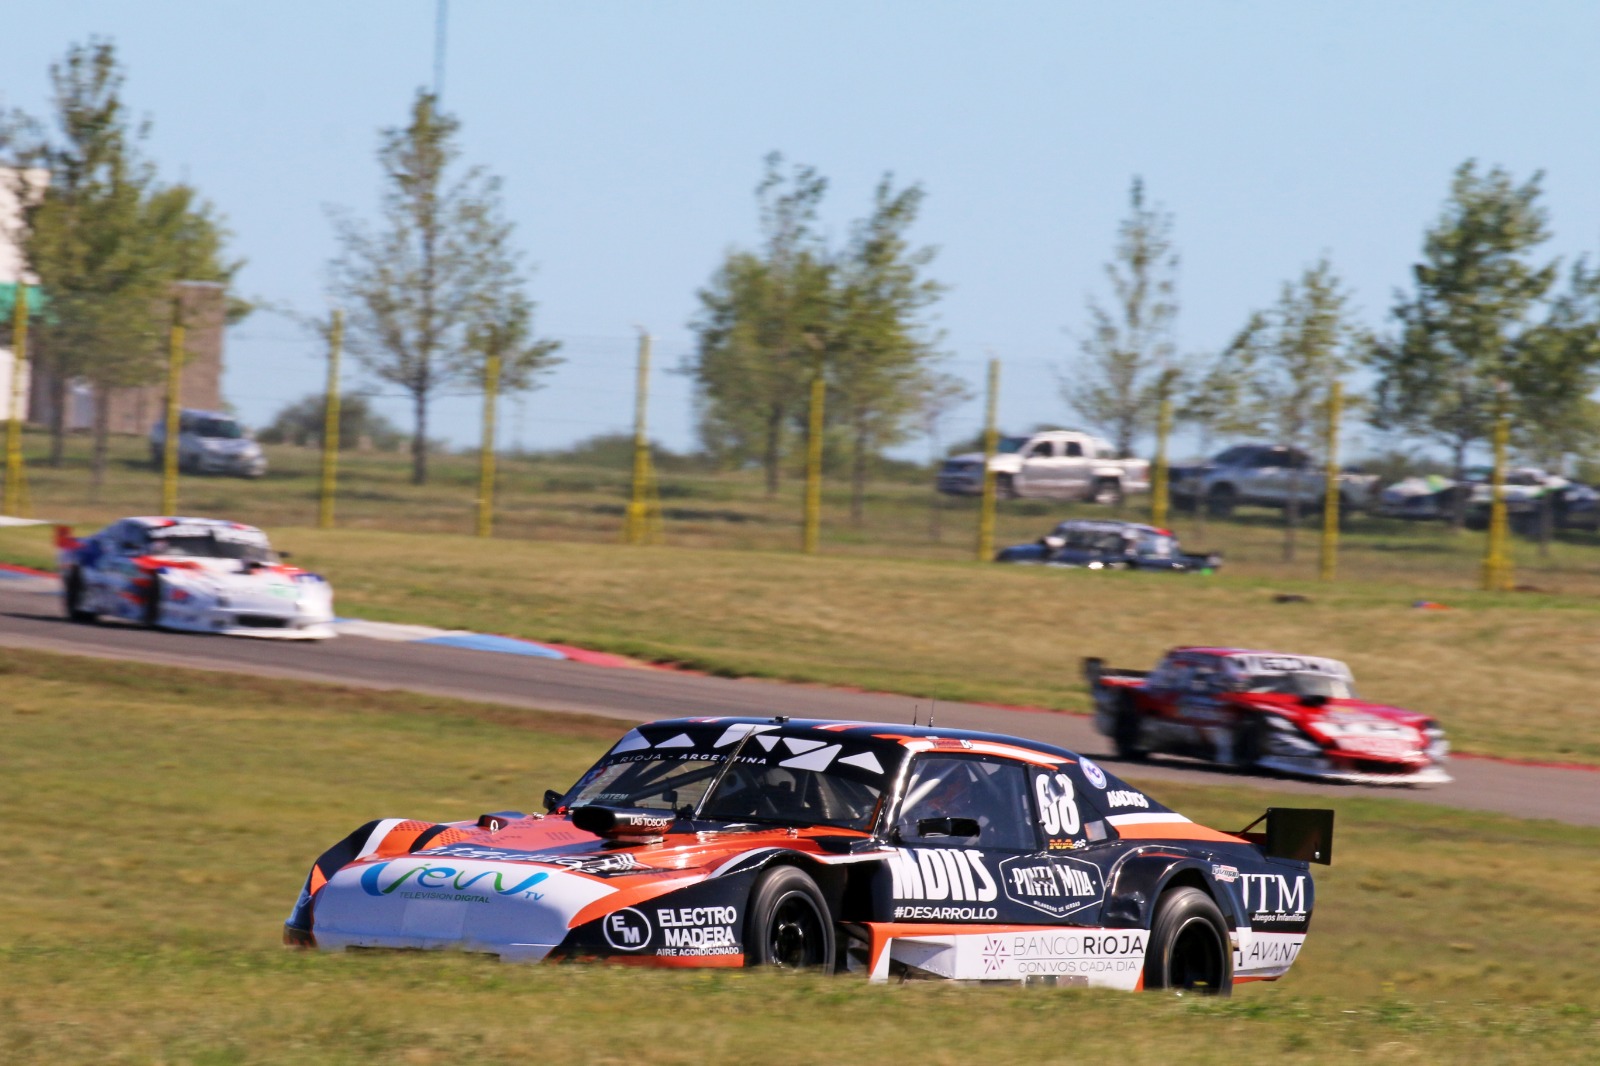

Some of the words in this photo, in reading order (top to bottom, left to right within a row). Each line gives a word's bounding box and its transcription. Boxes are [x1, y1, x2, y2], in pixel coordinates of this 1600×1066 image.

[620, 753, 662, 764] RIOJA
[679, 753, 767, 764] ARGENTINA
[630, 817, 643, 826] LAS
[643, 817, 667, 827] TOSCAS
[399, 892, 454, 901] TELEVISION
[454, 894, 490, 903] DIGITAL
[524, 891, 545, 901] TV
[657, 905, 737, 927] ELECTRO
[893, 906, 998, 920] #DESARROLLO
[1252, 914, 1275, 923] Juegos
[1276, 913, 1306, 922] Infantiles
[664, 926, 736, 948] MADERA
[1014, 936, 1079, 956] BANCO
[656, 948, 678, 957] AIRE
[679, 948, 740, 957] ACONDICIONADO
[1018, 962, 1047, 973] CON
[1049, 962, 1077, 973] VOS
[1079, 961, 1113, 972] CADA
[1116, 961, 1137, 971] DIA
